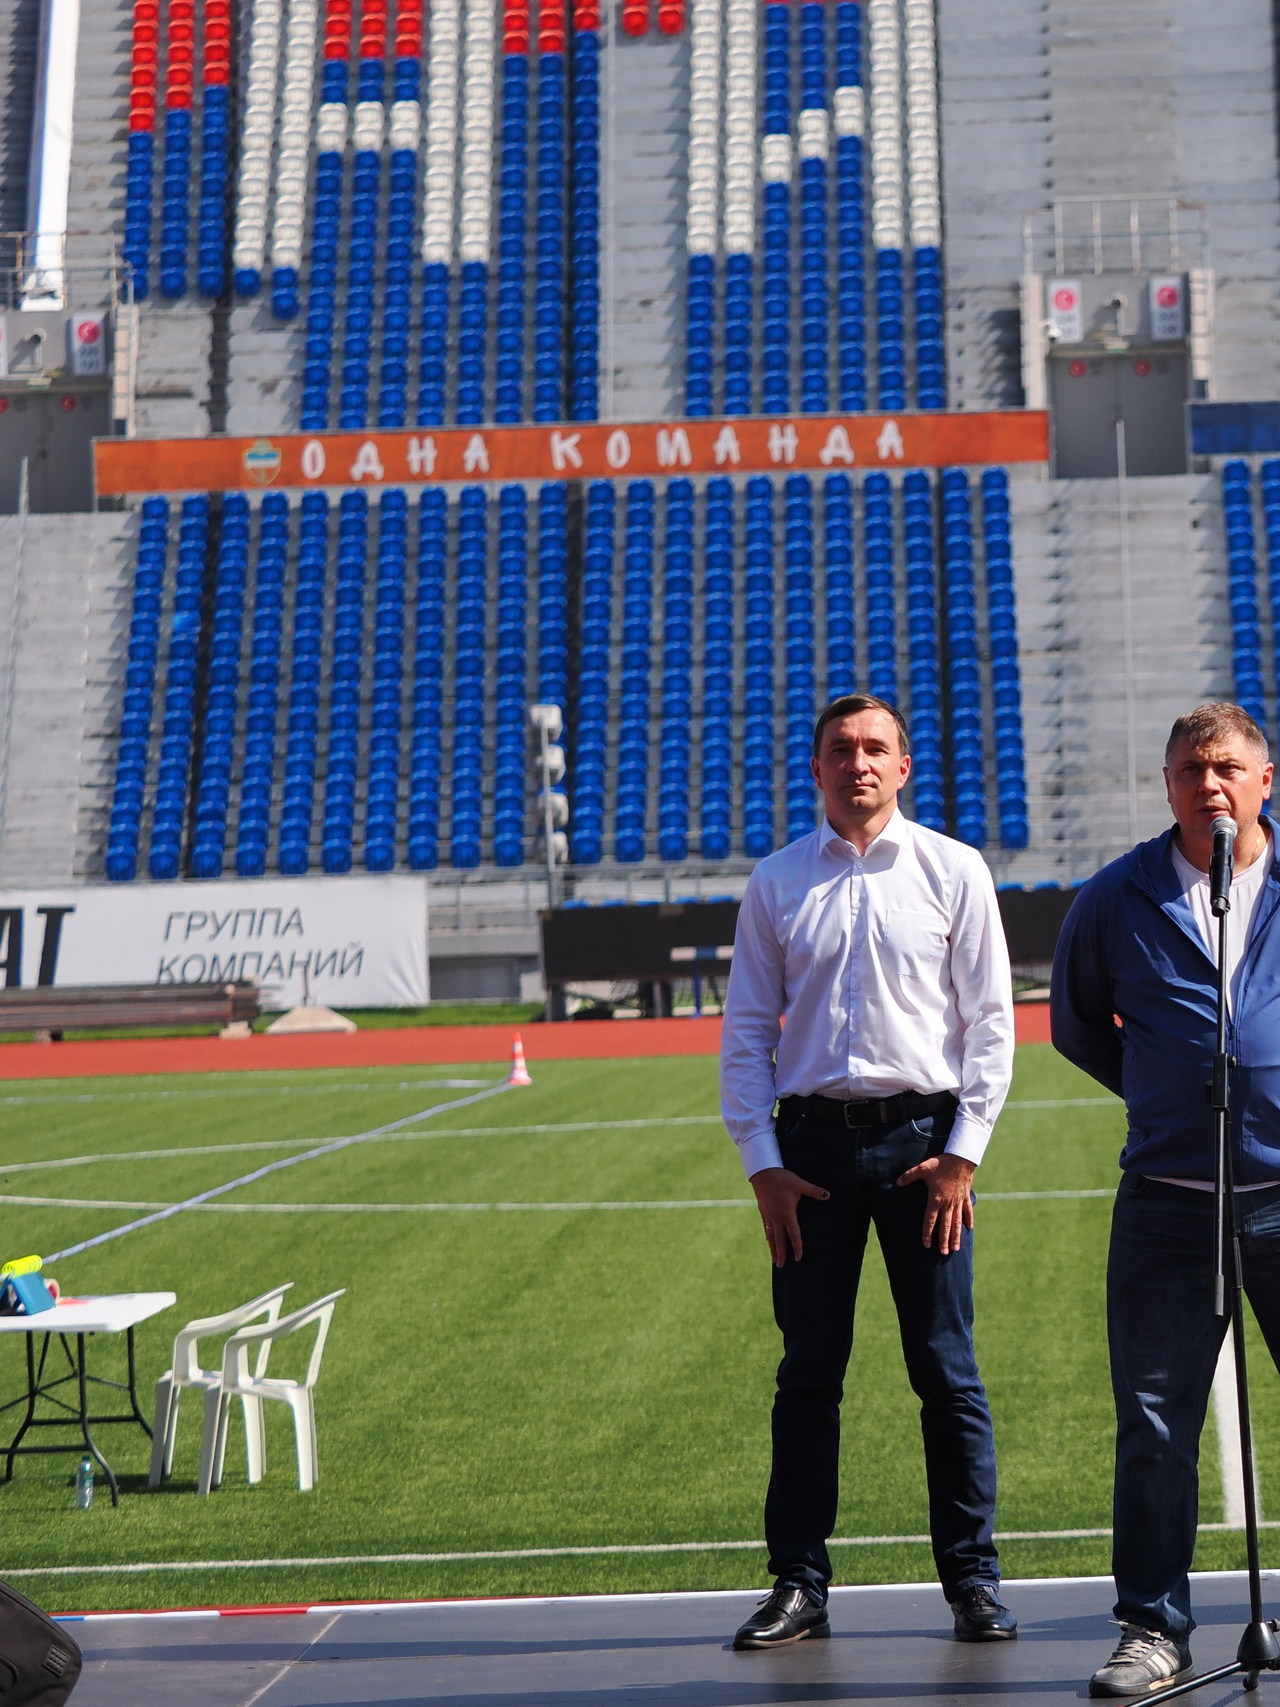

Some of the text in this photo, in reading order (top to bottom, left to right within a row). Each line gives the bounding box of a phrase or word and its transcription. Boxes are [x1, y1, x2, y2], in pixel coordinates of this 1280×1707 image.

[302, 419, 905, 482] ОДНА КОМАНДА
[164, 907, 304, 942] ГРУППА
[157, 942, 365, 985] КОМПАНИЙ
